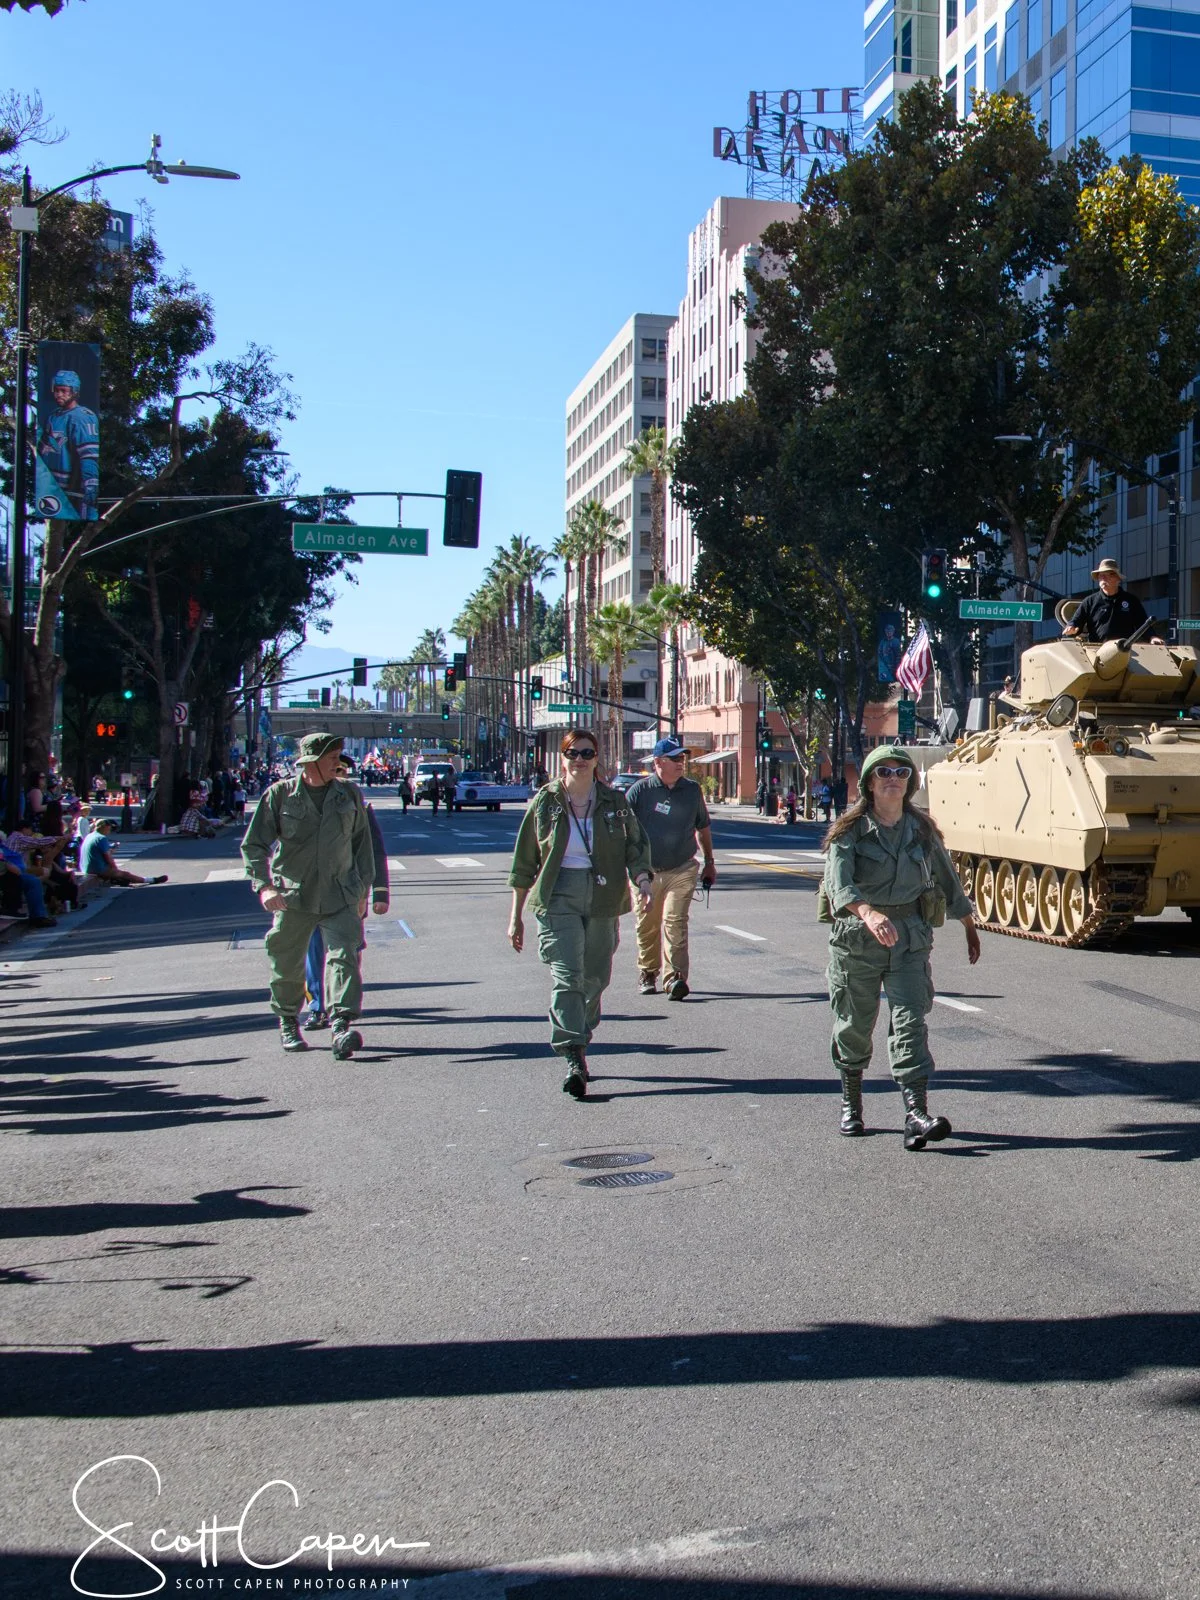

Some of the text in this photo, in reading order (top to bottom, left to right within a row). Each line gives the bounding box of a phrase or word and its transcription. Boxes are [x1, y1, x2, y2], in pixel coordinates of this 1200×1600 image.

[750, 87, 860, 116] HOTE
[782, 124, 846, 154] AN
[304, 530, 418, 548] Almaden Ave
[967, 604, 1036, 617] Almaden Ave
